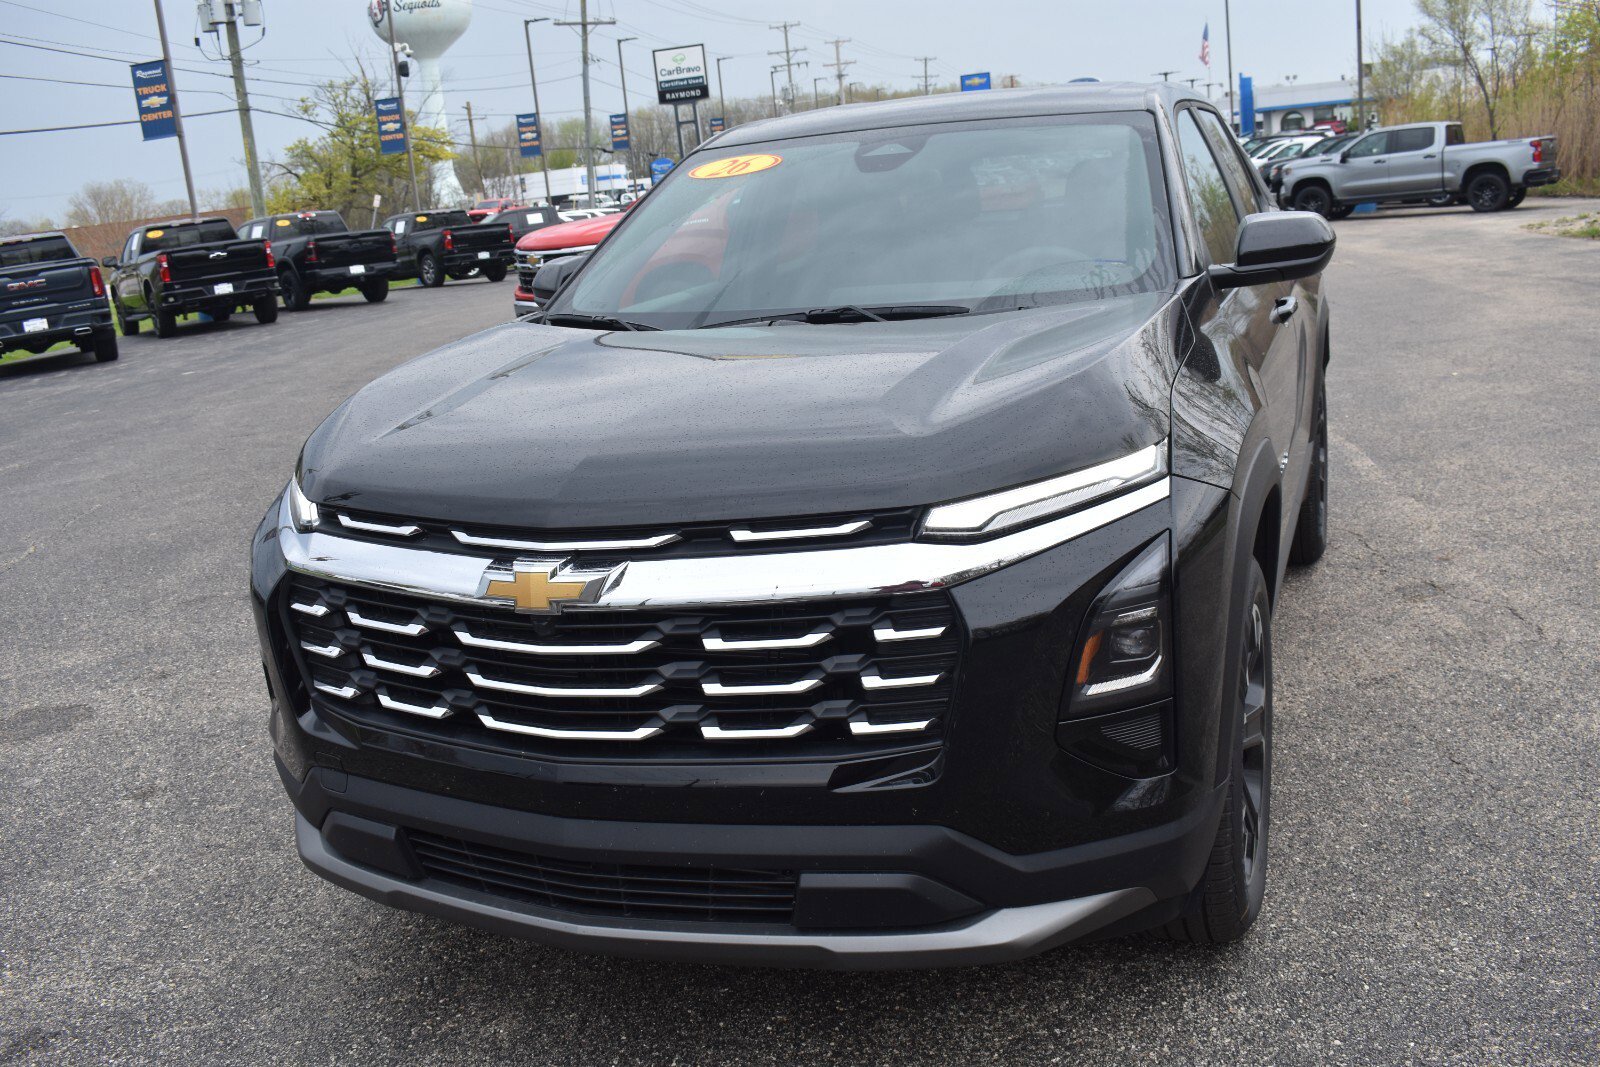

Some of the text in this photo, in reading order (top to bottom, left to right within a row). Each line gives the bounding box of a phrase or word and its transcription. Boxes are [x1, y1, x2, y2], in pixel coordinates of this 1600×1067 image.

[660, 65, 701, 77] CarBravo
[137, 83, 167, 96] TRUCK
[661, 80, 688, 88] Certified
[665, 89, 701, 100] RAYMOND
[141, 110, 173, 122] CENTER
[378, 114, 400, 122] TRUCK
[380, 133, 404, 141] CENTER
